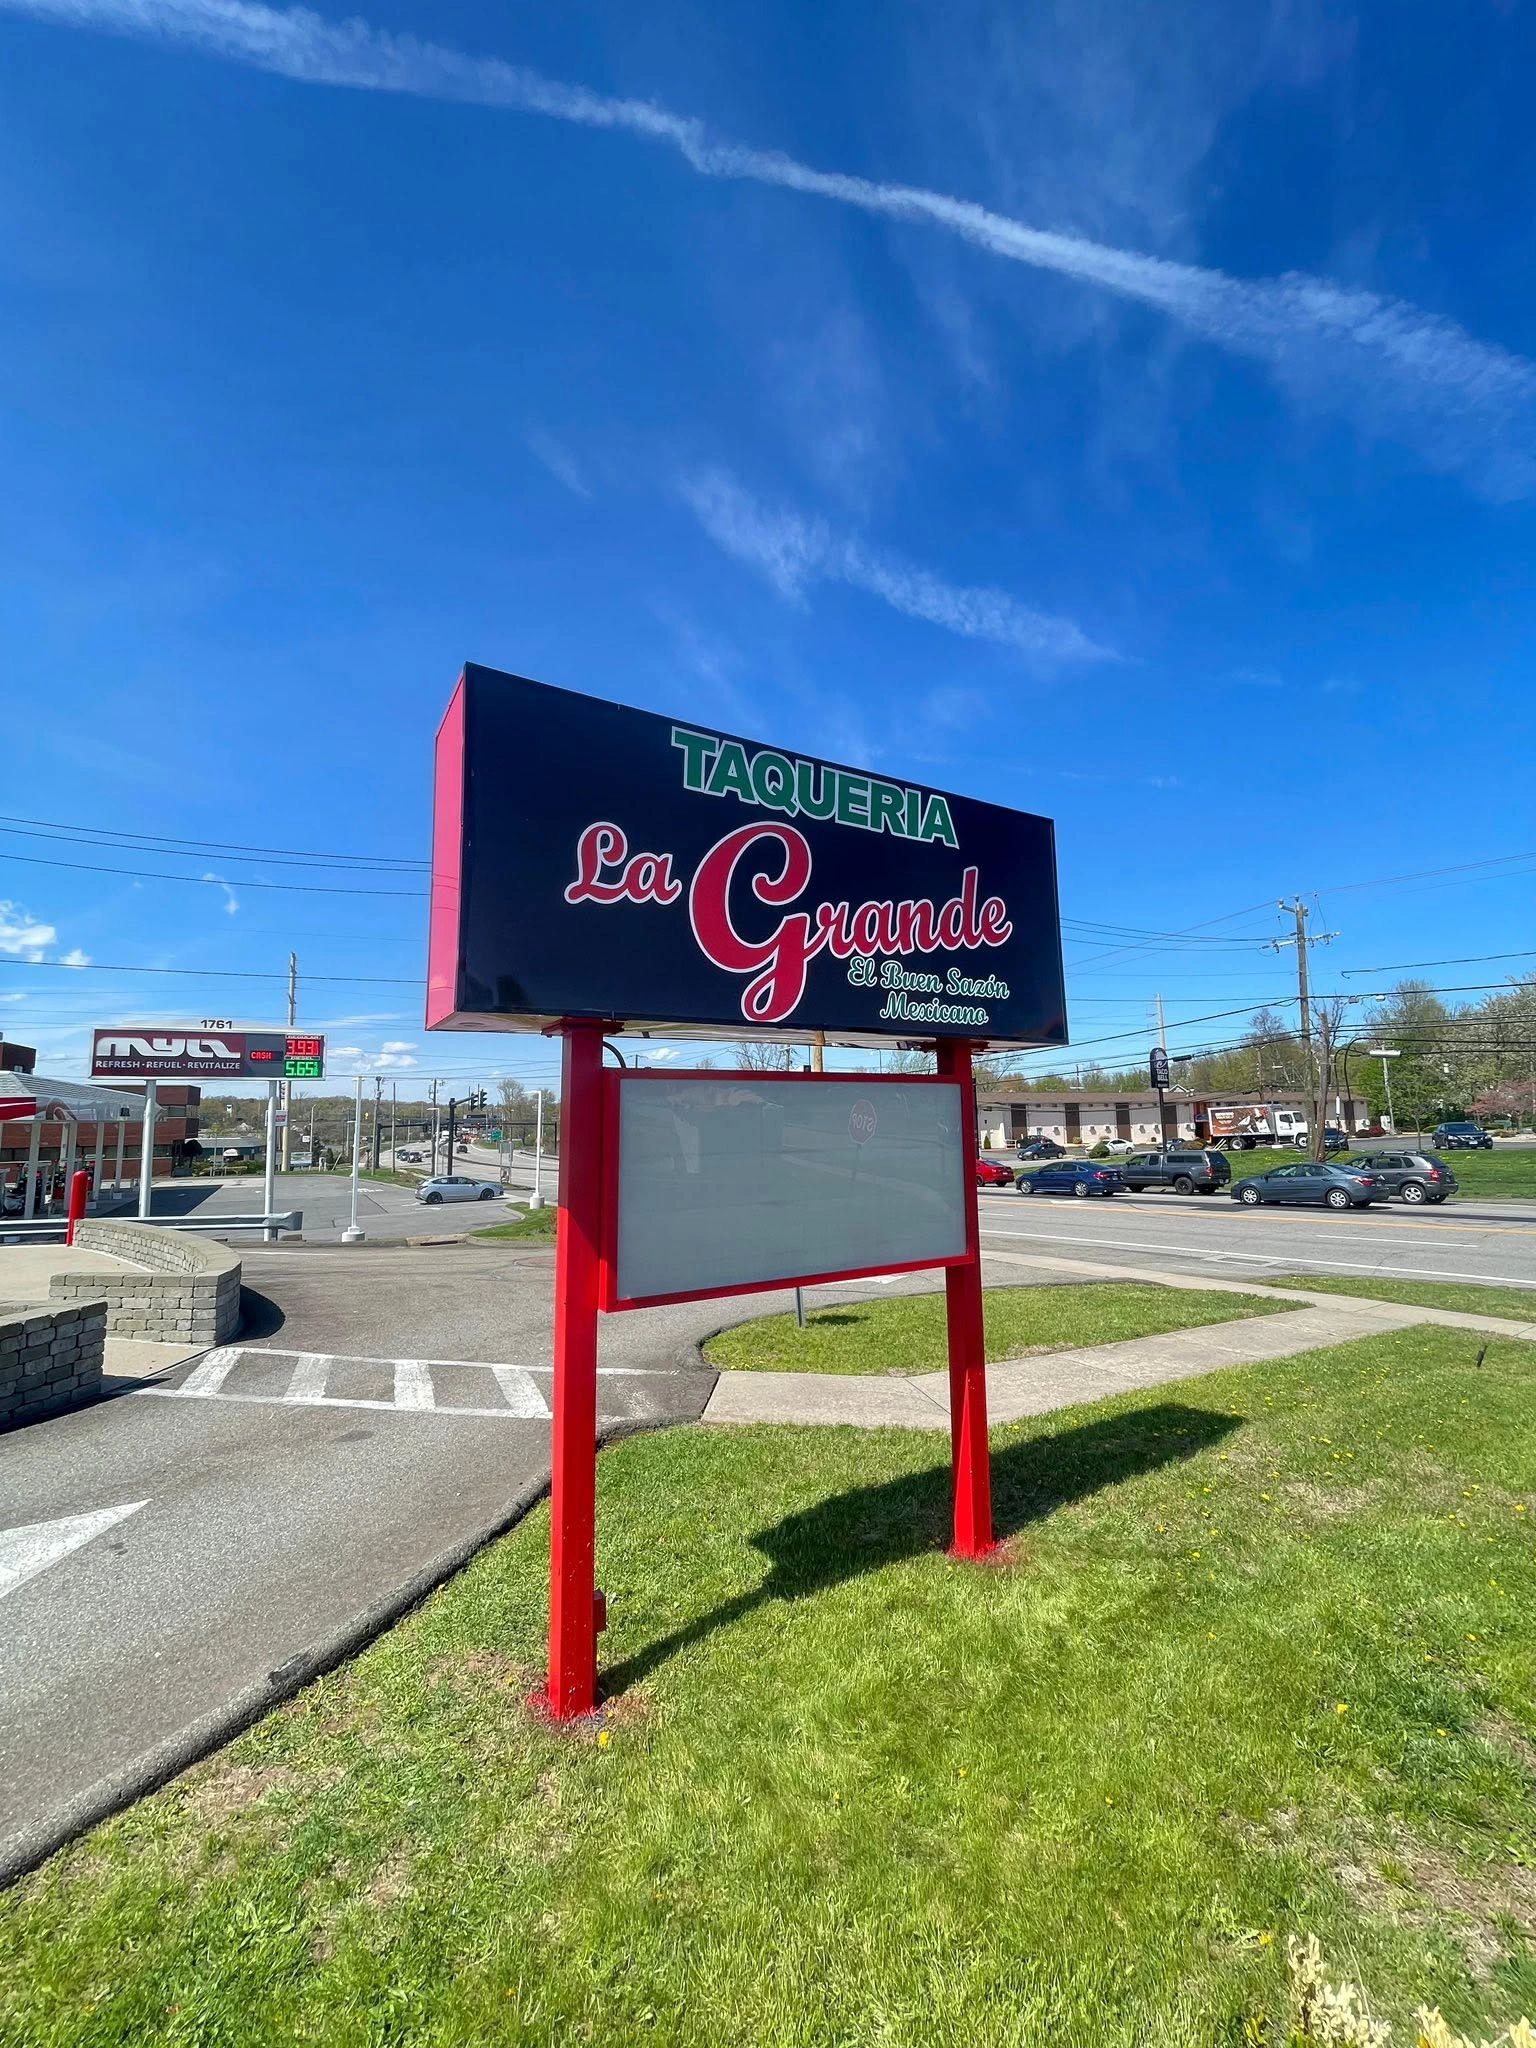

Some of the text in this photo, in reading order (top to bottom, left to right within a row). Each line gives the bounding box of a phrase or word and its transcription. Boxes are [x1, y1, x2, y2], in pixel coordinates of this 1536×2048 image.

[671, 726, 959, 849] TAQUERIA
[564, 821, 1013, 1022] La Grande
[848, 956, 1010, 999] El Buen Sazón
[200, 1020, 232, 1029] 1761
[880, 991, 989, 1025] Mexicano
[146, 1061, 181, 1069] REFUEL
[251, 1051, 272, 1059] CASH
